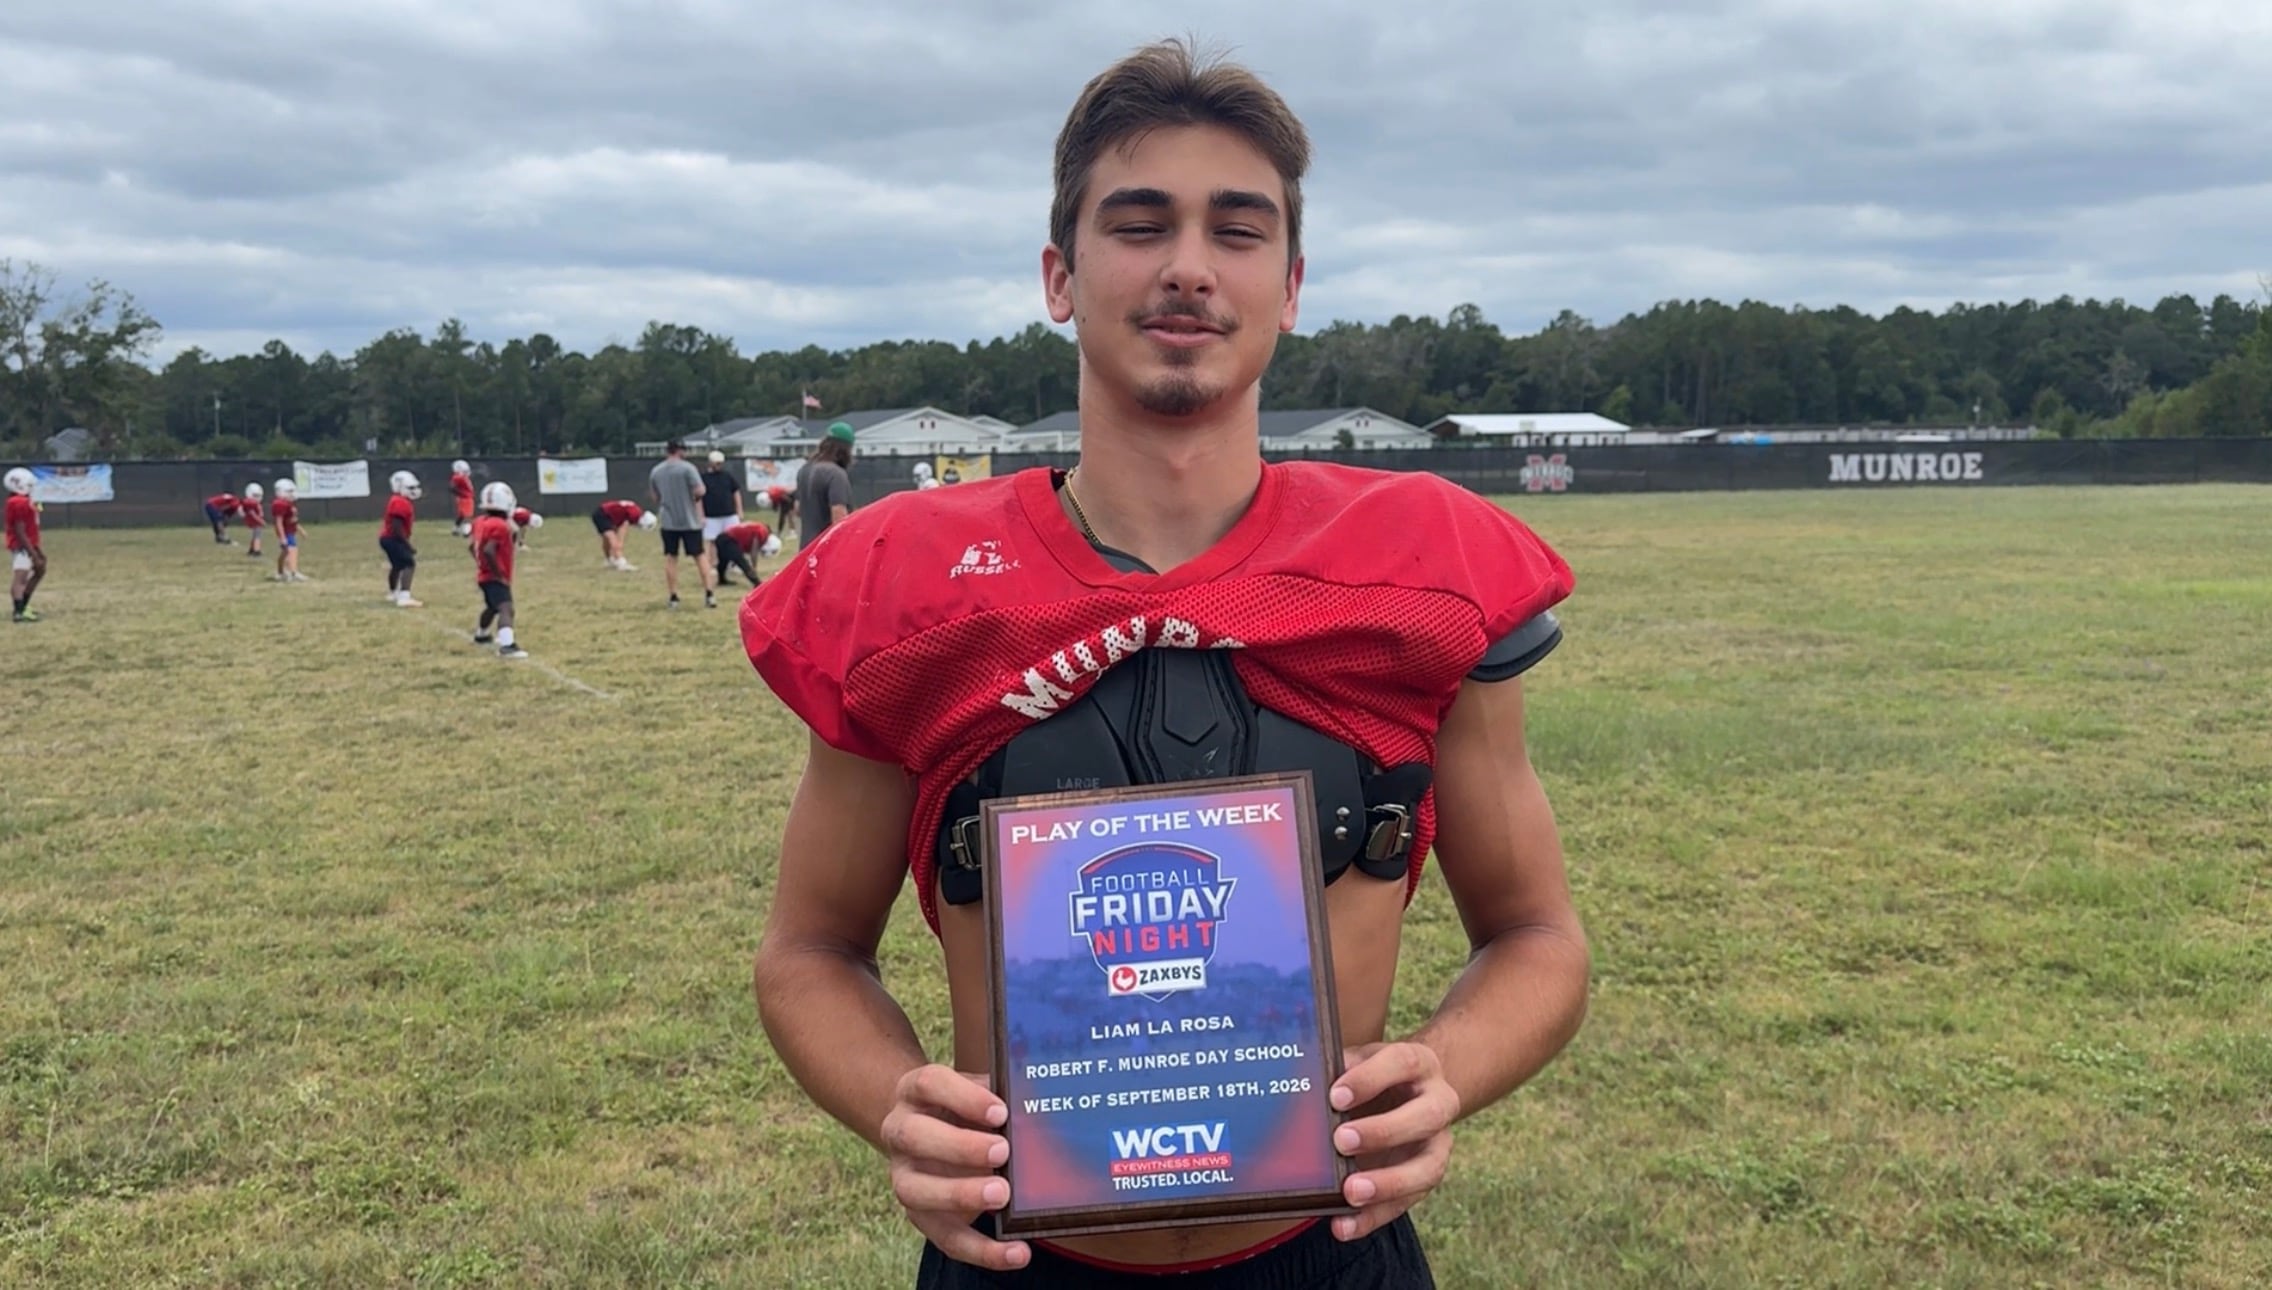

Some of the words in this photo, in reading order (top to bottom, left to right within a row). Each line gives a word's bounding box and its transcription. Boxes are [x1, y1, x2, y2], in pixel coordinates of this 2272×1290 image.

[1829, 452, 1983, 481] MUNROE
[1056, 777, 1100, 789] LARGE
[1011, 821, 1083, 844] PLAY
[1090, 816, 1127, 837] OF
[1134, 811, 1190, 833] THE
[1197, 803, 1281, 828] WEEK
[1092, 868, 1209, 893] FOOTBALL
[1076, 886, 1227, 929] FRIDAY
[1094, 921, 1213, 955] NIGHT
[1139, 965, 1201, 985] ZAXBYS
[1091, 1023, 1140, 1039] LIAM
[1148, 1020, 1173, 1034] LA
[1181, 1016, 1234, 1032] ROSA
[1026, 1061, 1092, 1079] ROBERT
[1098, 1060, 1113, 1073] F.
[1118, 1052, 1191, 1071] MUNROE
[1195, 1049, 1229, 1064] DAY
[1234, 1044, 1304, 1062] SCHOOL
[1024, 1097, 1074, 1114] WEEK
[1079, 1094, 1101, 1108] OF
[1107, 1085, 1210, 1106] SEPTEMBER
[1217, 1081, 1264, 1098] 18TH,
[1269, 1078, 1311, 1094] 2026
[1112, 1123, 1224, 1159] WCTV
[1113, 1158, 1191, 1173] EYEWITNESS
[1192, 1155, 1229, 1168] NEWS
[1112, 1173, 1180, 1190] TRUSTED.
[1183, 1169, 1234, 1185] LOCAL.
